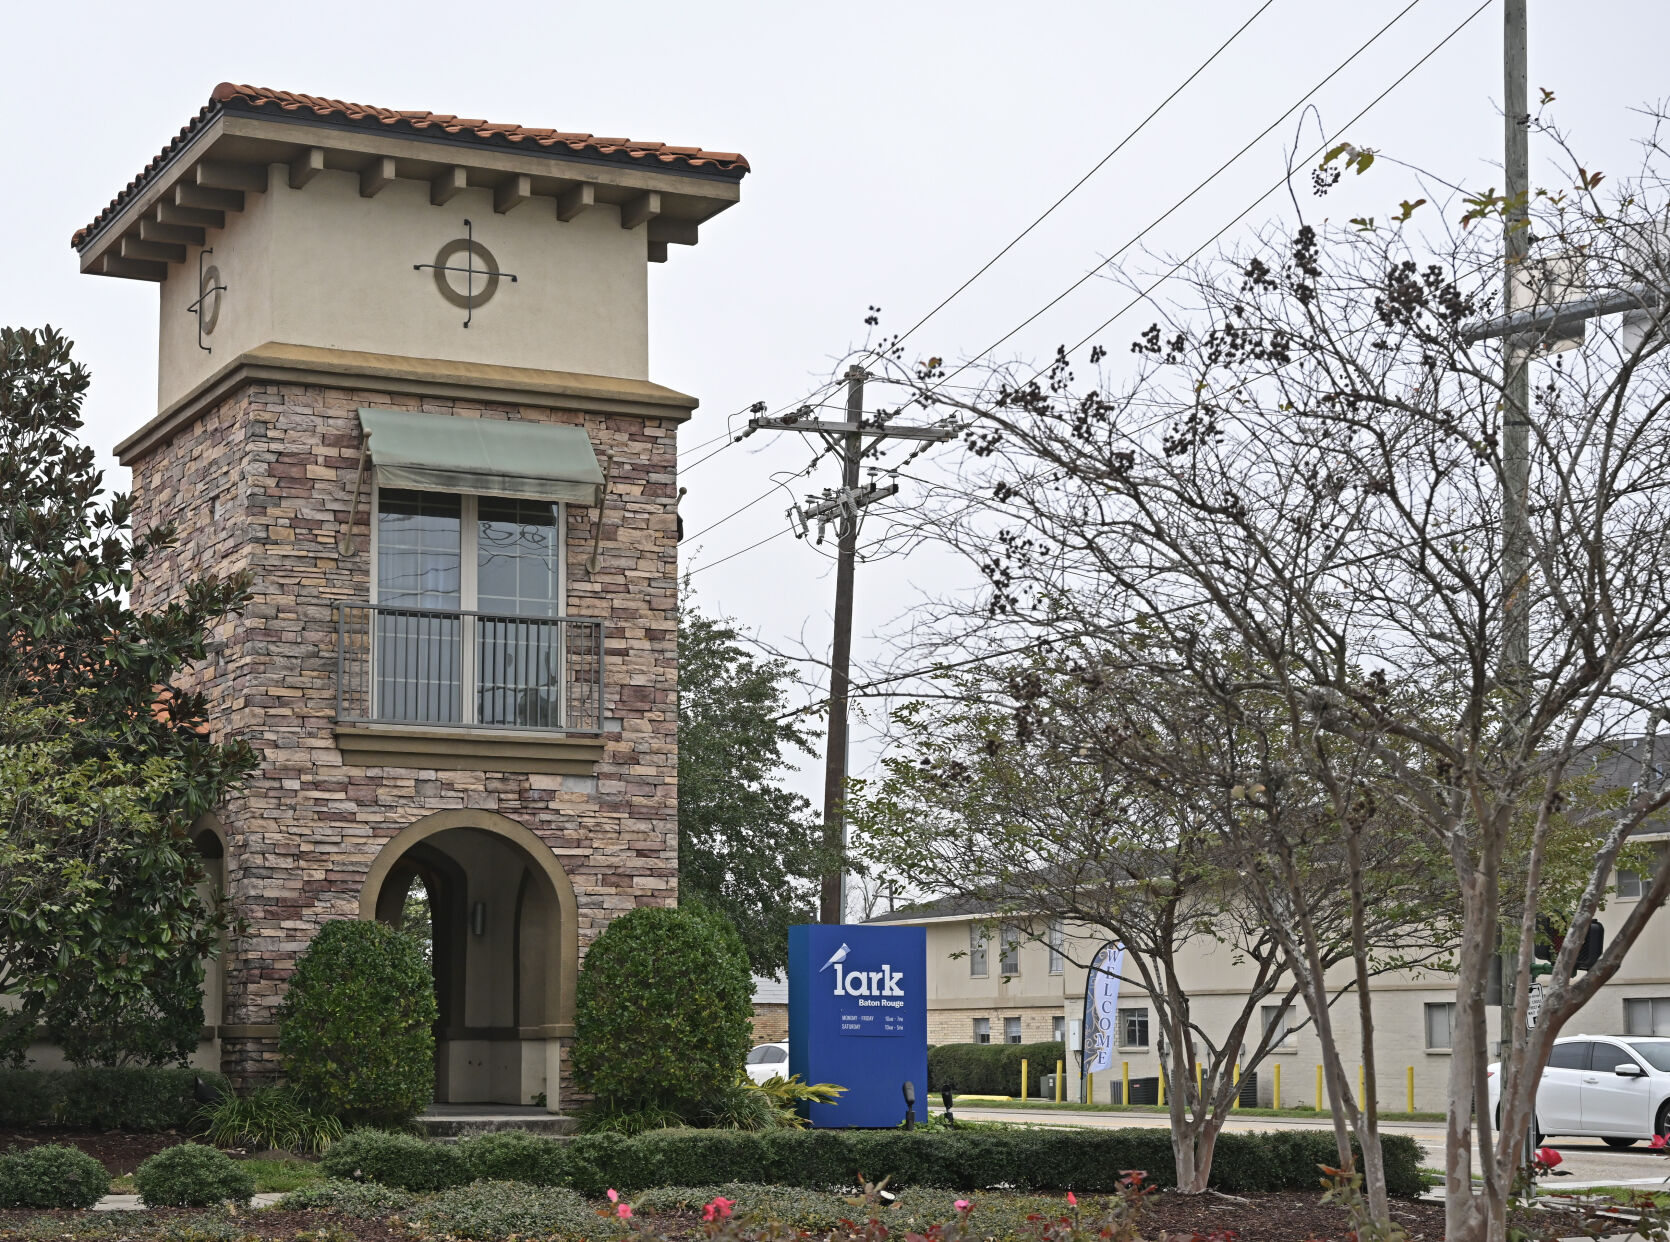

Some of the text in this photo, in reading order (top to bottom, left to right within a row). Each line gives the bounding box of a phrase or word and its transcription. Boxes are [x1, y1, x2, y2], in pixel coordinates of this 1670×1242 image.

[834, 963, 904, 996] lark
[881, 999, 904, 1008] Rouge
[1096, 950, 1119, 1065] WELCOME
